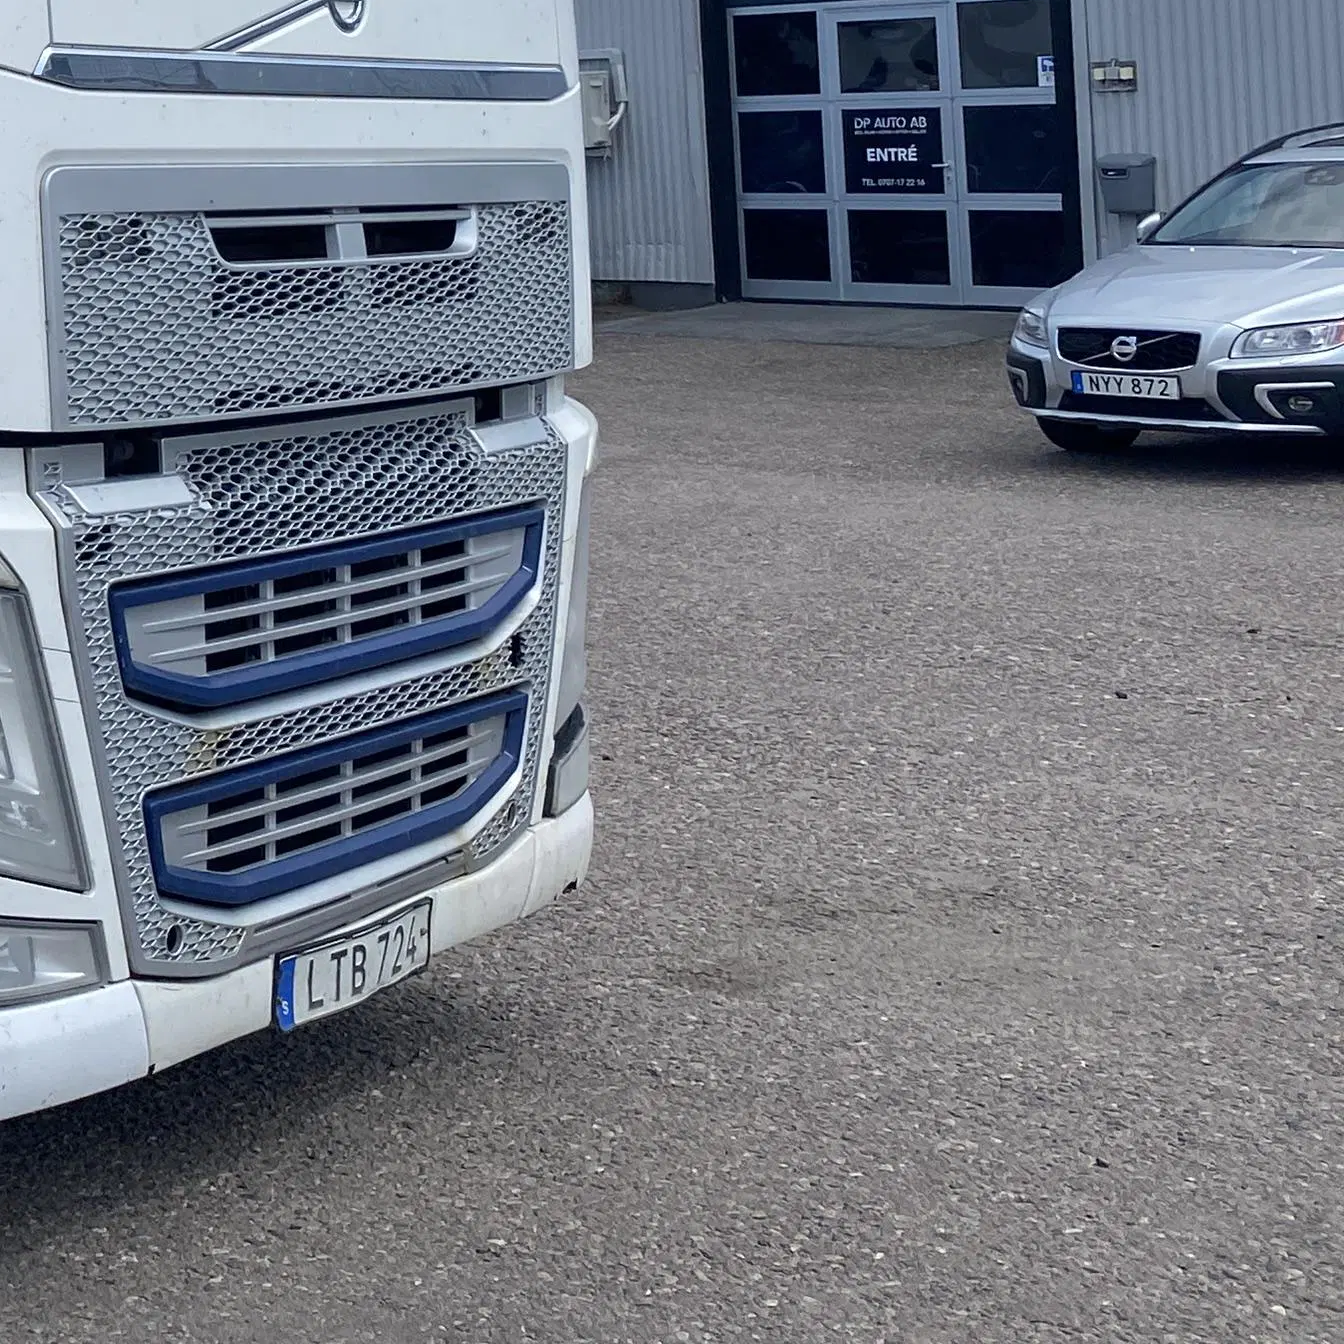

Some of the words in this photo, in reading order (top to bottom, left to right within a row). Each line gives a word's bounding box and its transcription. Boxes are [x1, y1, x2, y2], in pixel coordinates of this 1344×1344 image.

[854, 117, 871, 129] DP
[874, 116, 906, 128] AUTO
[910, 116, 927, 128] AB
[866, 144, 918, 162] ENTRÉ
[1088, 375, 1124, 393] NYY
[1131, 378, 1170, 397] 872
[308, 944, 366, 1011] LTB
[377, 916, 417, 985] 724
[281, 1000, 290, 1016] S
